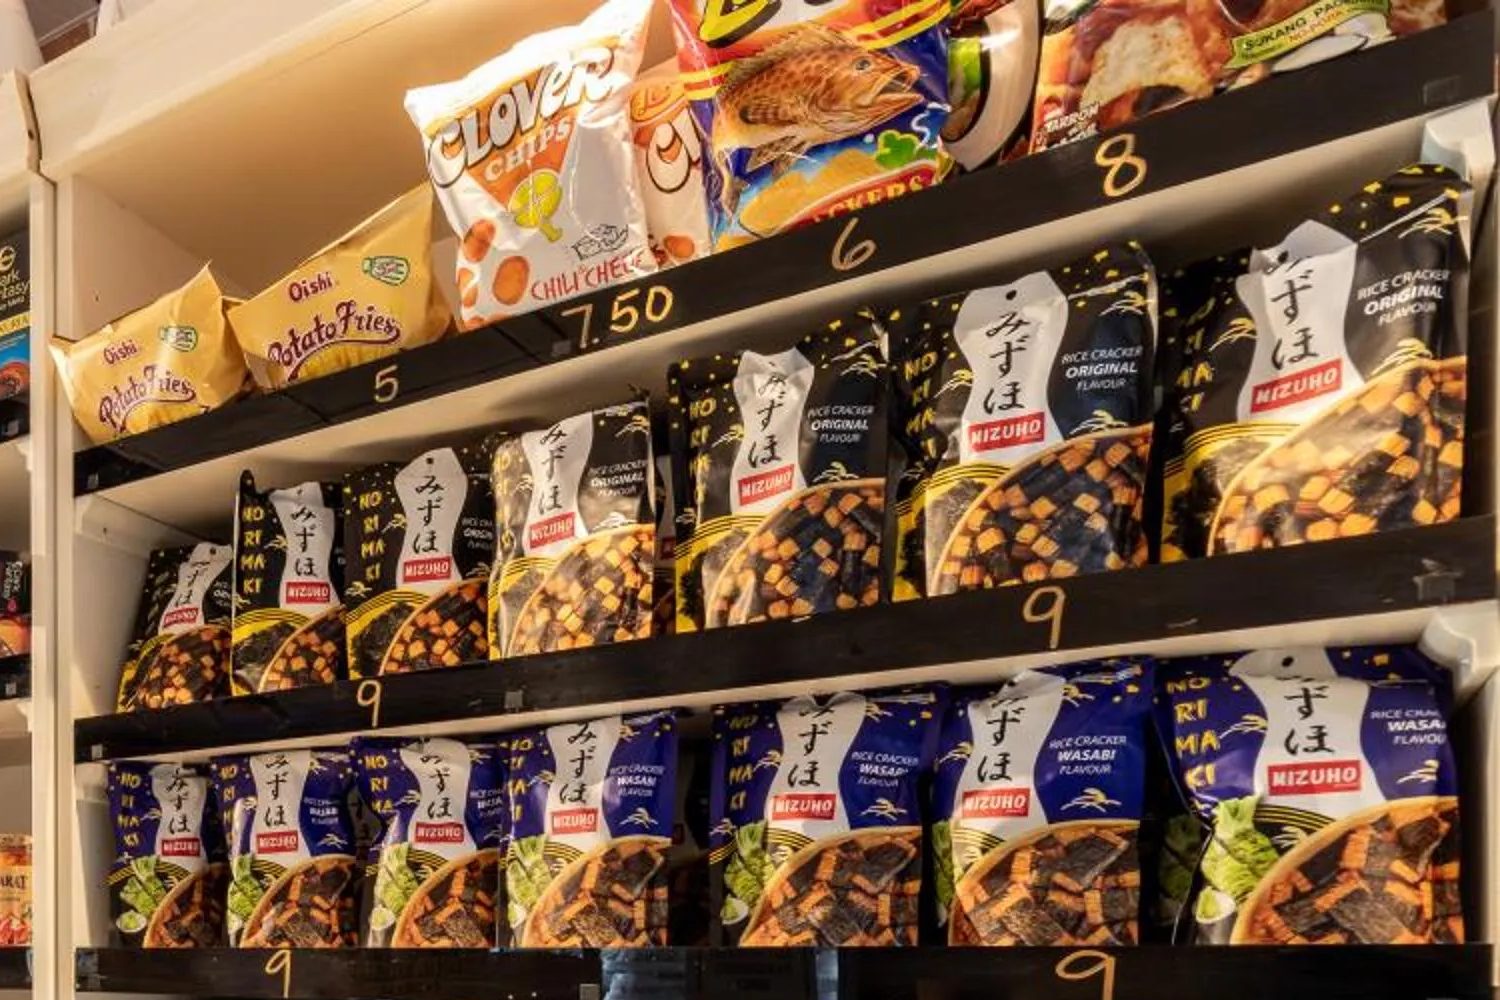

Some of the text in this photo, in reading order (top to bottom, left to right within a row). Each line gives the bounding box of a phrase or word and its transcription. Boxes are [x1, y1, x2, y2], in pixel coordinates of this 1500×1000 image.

[426, 45, 620, 189] CLOVER
[483, 115, 575, 182] CHIPS
[1094, 132, 1148, 199] 8
[831, 217, 878, 272] 6
[288, 271, 333, 302] Oishi
[530, 272, 579, 302] CHILI
[1357, 269, 1450, 301] RICE CRACKER
[1363, 285, 1444, 316] ORIGINAL
[561, 285, 675, 350] 7.50
[1377, 301, 1437, 327] FLAVOUR
[268, 300, 400, 367] Potato Fries
[103, 339, 139, 365] Oishi
[982, 310, 1031, 416] みずほ
[1090, 345, 1143, 361] CRACKER
[1064, 361, 1139, 379] ORIGINAL
[373, 364, 400, 404] 5
[1255, 368, 1340, 406] MIZUHO
[810, 418, 870, 432] ORIGINAL
[970, 419, 1043, 444] MIZUHO
[741, 472, 794, 499] MIZUHO
[359, 491, 382, 510] NO
[241, 505, 265, 522] NO
[411, 473, 446, 556] みずほ
[289, 502, 320, 579] みずほ
[530, 516, 575, 543] MIZUHO
[360, 539, 386, 559] MA
[240, 554, 267, 571] MA
[364, 564, 383, 582] KI
[403, 560, 451, 581] MIZUHO
[242, 577, 263, 595] KI
[285, 583, 331, 601] MIZUHO
[1021, 585, 1067, 650] 9
[356, 679, 383, 728] 9
[1174, 699, 1209, 724] RI
[1370, 708, 1399, 720] RICE
[1387, 719, 1447, 733] WASA
[1049, 735, 1128, 750] RICE CRACKER
[1174, 730, 1221, 756] MA
[1393, 733, 1447, 746] FLAVOU
[559, 722, 597, 806] みずほ
[1057, 749, 1117, 763] WASABI
[1059, 762, 1112, 775] FLAVOUR
[1185, 765, 1217, 789] KI
[1269, 765, 1359, 790] MIZUHO
[772, 797, 834, 816] MIZUHO
[963, 791, 1028, 815] MIZUHO
[414, 825, 463, 842] MIZUHO
[551, 813, 597, 832] MIZUHO
[264, 948, 292, 999] 9
